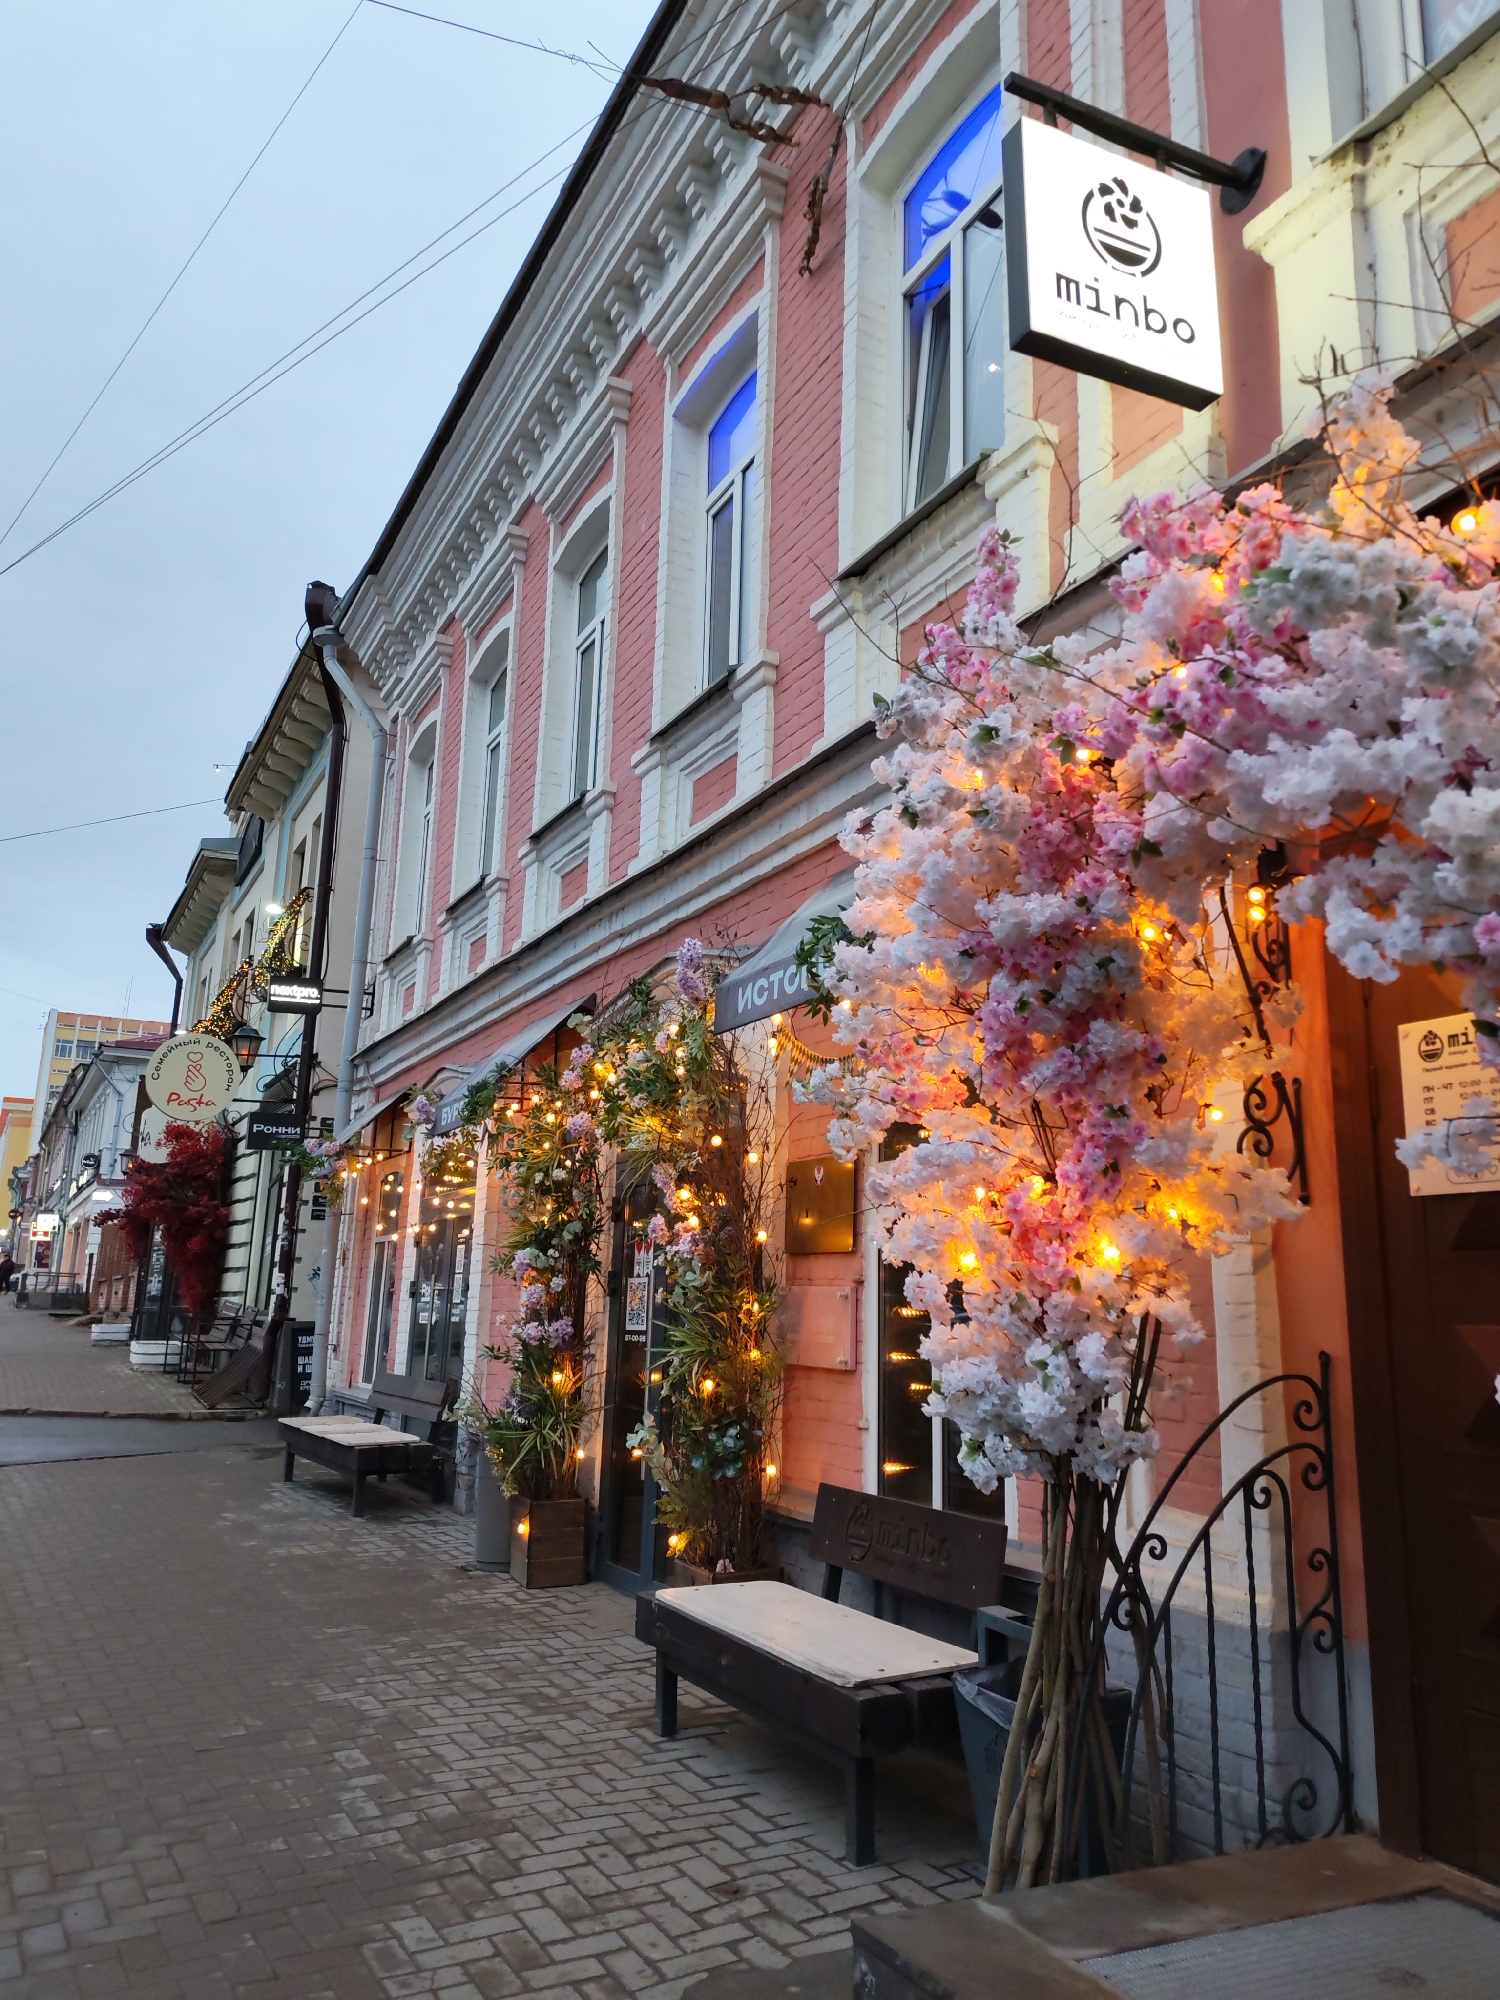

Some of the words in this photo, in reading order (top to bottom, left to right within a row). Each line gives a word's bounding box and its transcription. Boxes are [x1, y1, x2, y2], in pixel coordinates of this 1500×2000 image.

[1055, 271, 1196, 344] minbo
[1447, 1026, 1474, 1048] mi
[151, 1037, 201, 1081] Семейный
[205, 1041, 235, 1092] ресторан
[166, 1091, 217, 1113] Pasta
[1423, 1096, 1434, 1104] ПТ
[876, 1515, 951, 1567] minbo
